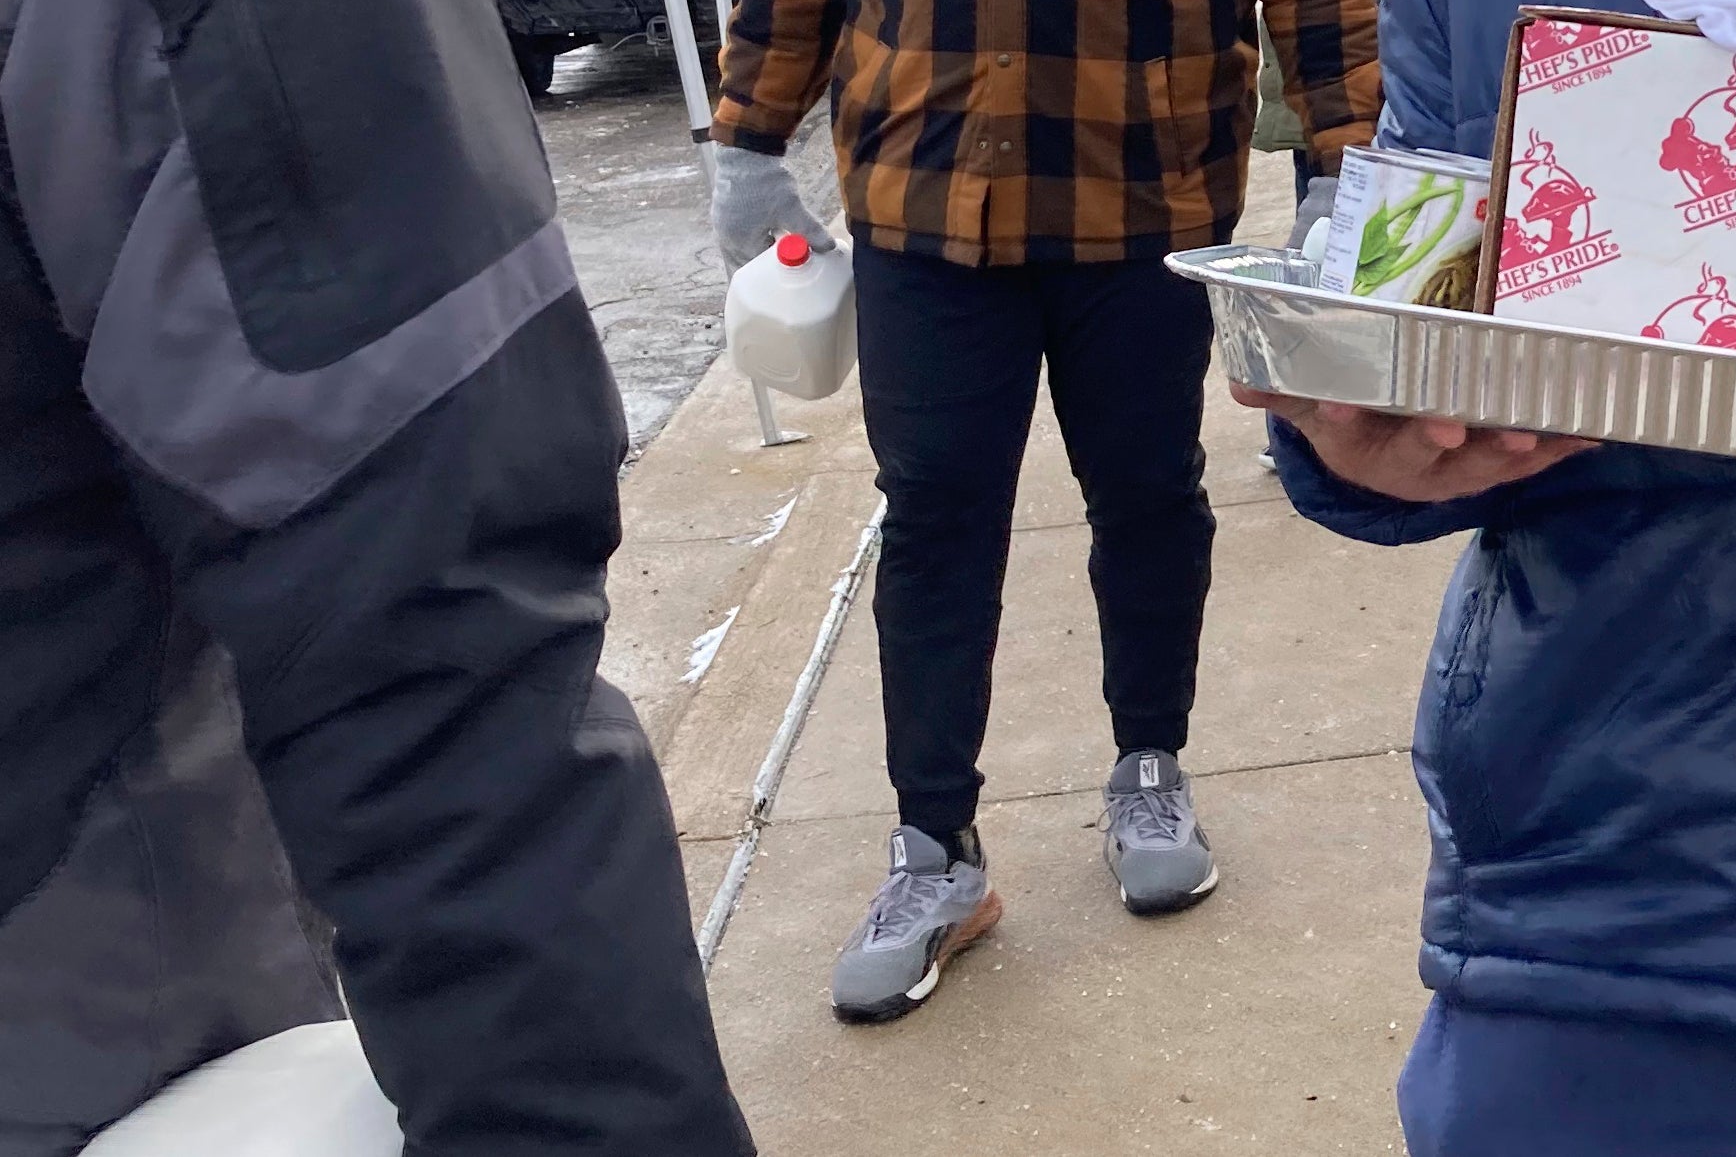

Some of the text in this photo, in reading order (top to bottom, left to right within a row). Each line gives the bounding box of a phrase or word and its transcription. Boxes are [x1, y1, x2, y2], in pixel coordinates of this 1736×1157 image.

[1552, 64, 1613, 94] SINCE 1894
[1497, 260, 1548, 293] HEF'S
[1522, 274, 1583, 303] SINCE 1894
